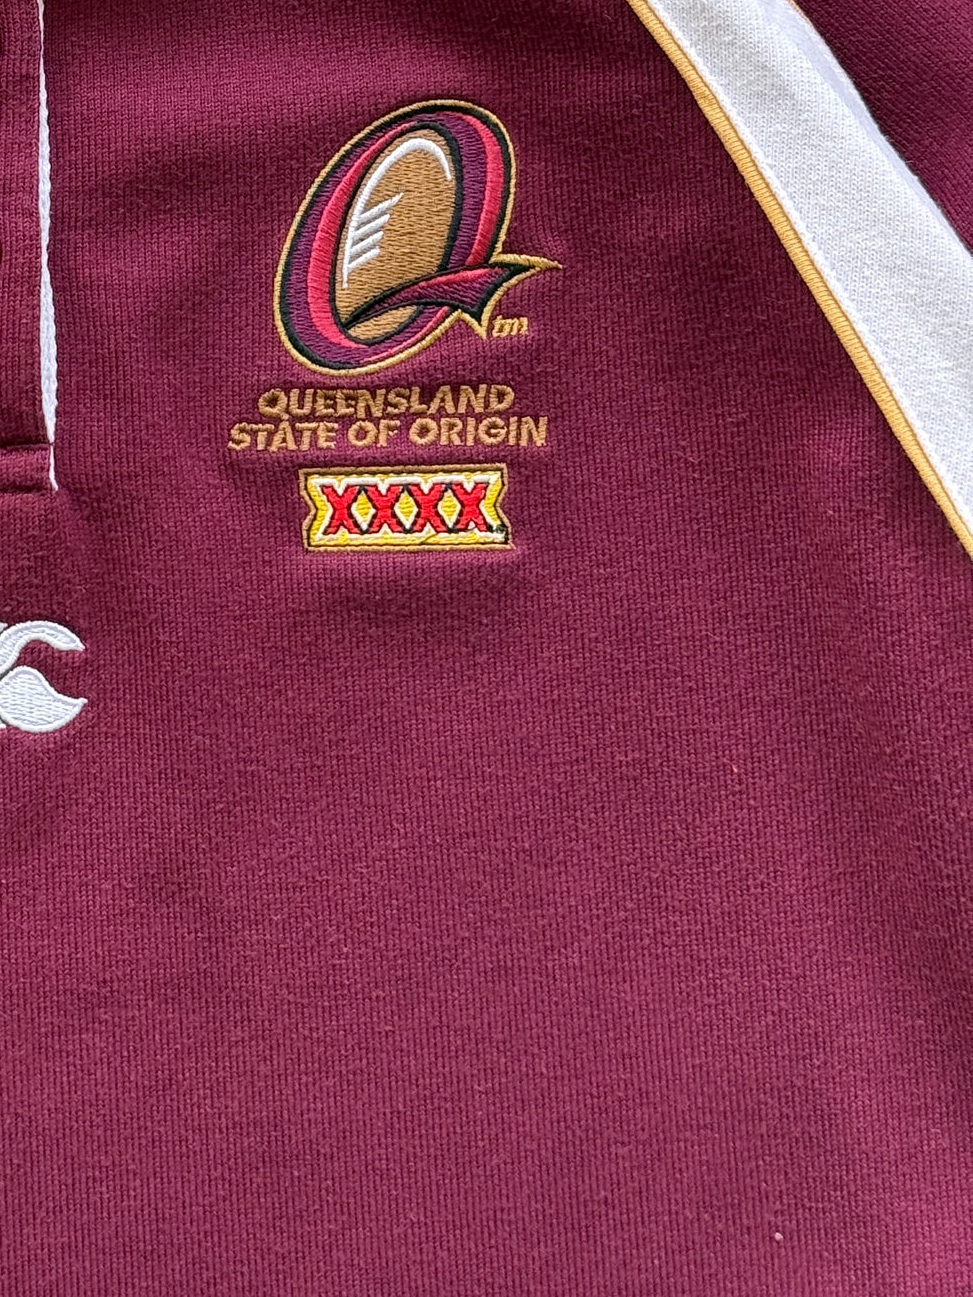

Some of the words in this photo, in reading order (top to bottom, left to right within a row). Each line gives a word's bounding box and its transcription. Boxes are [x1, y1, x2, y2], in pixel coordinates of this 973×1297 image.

[258, 384, 515, 419] QUEENSLAND
[228, 418, 336, 451] STATE
[348, 420, 401, 448] OF
[409, 416, 549, 448] ORIGIN
[321, 482, 490, 535] XXXX
